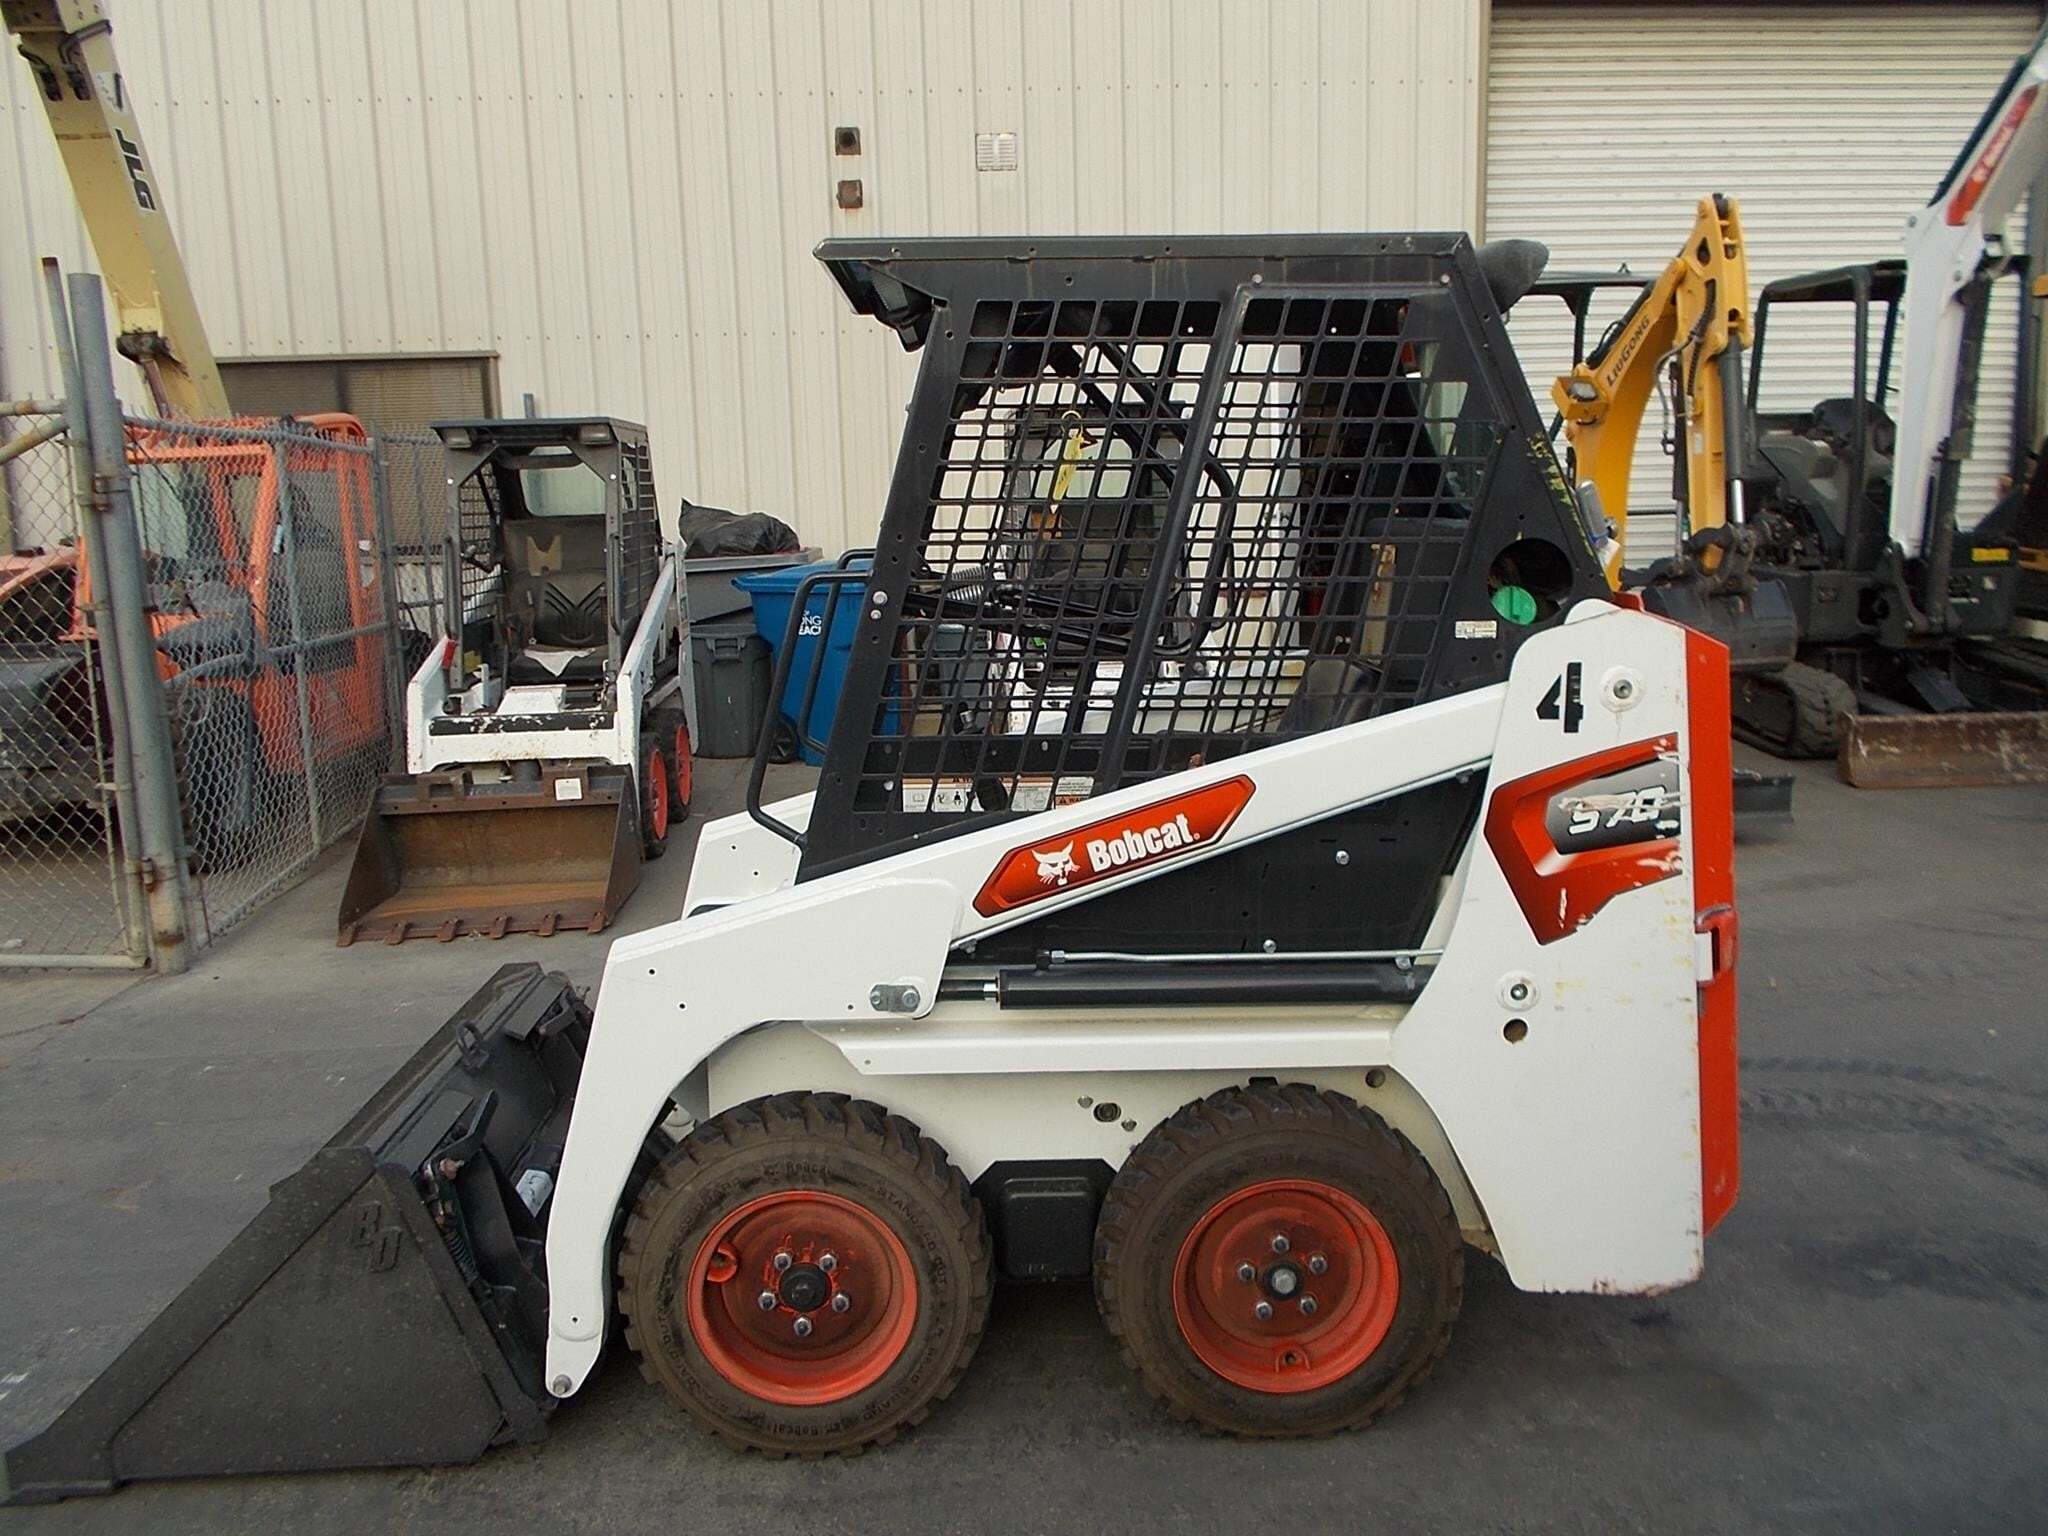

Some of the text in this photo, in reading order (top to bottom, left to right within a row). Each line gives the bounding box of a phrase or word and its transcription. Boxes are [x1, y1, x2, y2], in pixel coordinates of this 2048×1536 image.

[114, 127, 157, 211] JLG
[1536, 661, 1584, 734] 4
[1086, 813, 1194, 872] Bobcat
